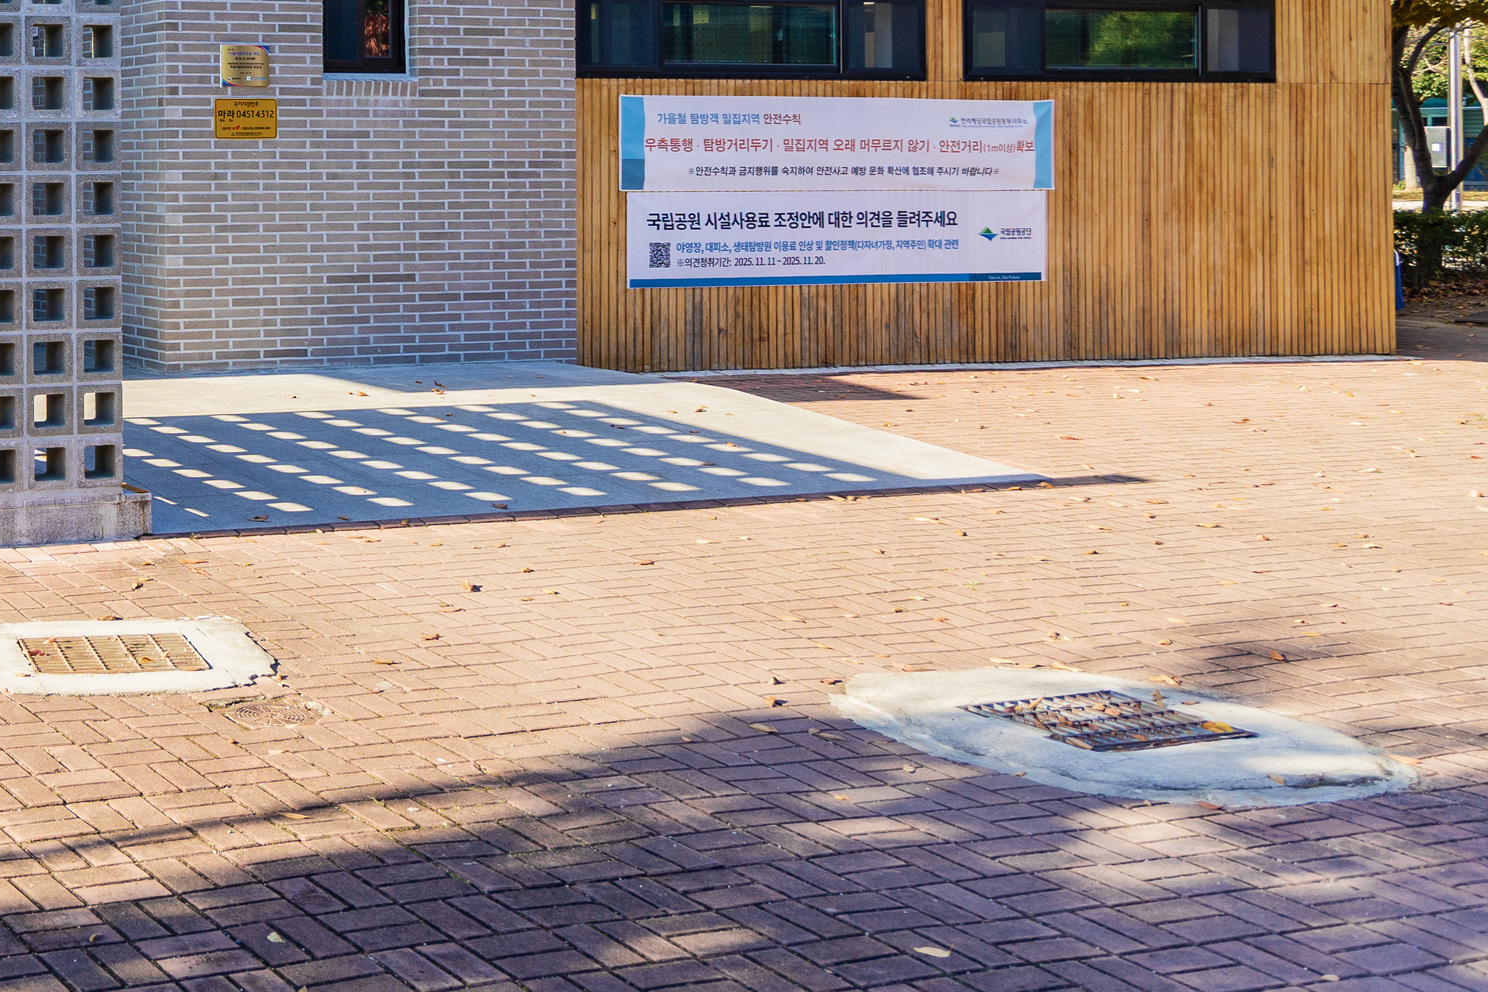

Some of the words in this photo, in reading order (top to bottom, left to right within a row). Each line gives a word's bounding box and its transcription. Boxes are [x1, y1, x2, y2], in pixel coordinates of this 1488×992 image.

[236, 110, 274, 118] 04514312
[657, 112, 687, 125] 가을철
[690, 113, 719, 125] 탐방객
[722, 113, 760, 125] 밀집지역
[763, 113, 802, 125] 안전수칙
[644, 137, 694, 153] 우측통행
[703, 138, 773, 153] 탐방거리두기
[783, 138, 829, 153] 밀집지역
[832, 139, 856, 153] 오래
[860, 139, 904, 153] 머무르지
[907, 139, 930, 153] 않기
[738, 166, 779, 176] 금지행위를
[781, 166, 814, 176] 숙지하여
[816, 166, 848, 176] 안전사고
[851, 166, 867, 176] 예방
[869, 166, 884, 176] 문화
[887, 166, 910, 176] 확산에
[912, 166, 935, 176] 협조해
[936, 166, 960, 176] 주시기
[646, 212, 701, 230] 국립공원
[704, 211, 771, 230] 시설사용료
[773, 211, 825, 229] 조정안에
[828, 211, 853, 229] 대한
[856, 210, 894, 228] 의견을
[896, 210, 958, 228] 들려주세요
[676, 241, 704, 254] 야영장,
[705, 241, 732, 253] 대피소,
[733, 241, 772, 253] 생태탐방원
[773, 240, 797, 251] 이용료
[798, 240, 814, 251] 인상
[815, 240, 823, 251] 및
[895, 239, 927, 251] 지역주민)
[927, 239, 943, 250] 확대
[943, 239, 959, 250] 관련
